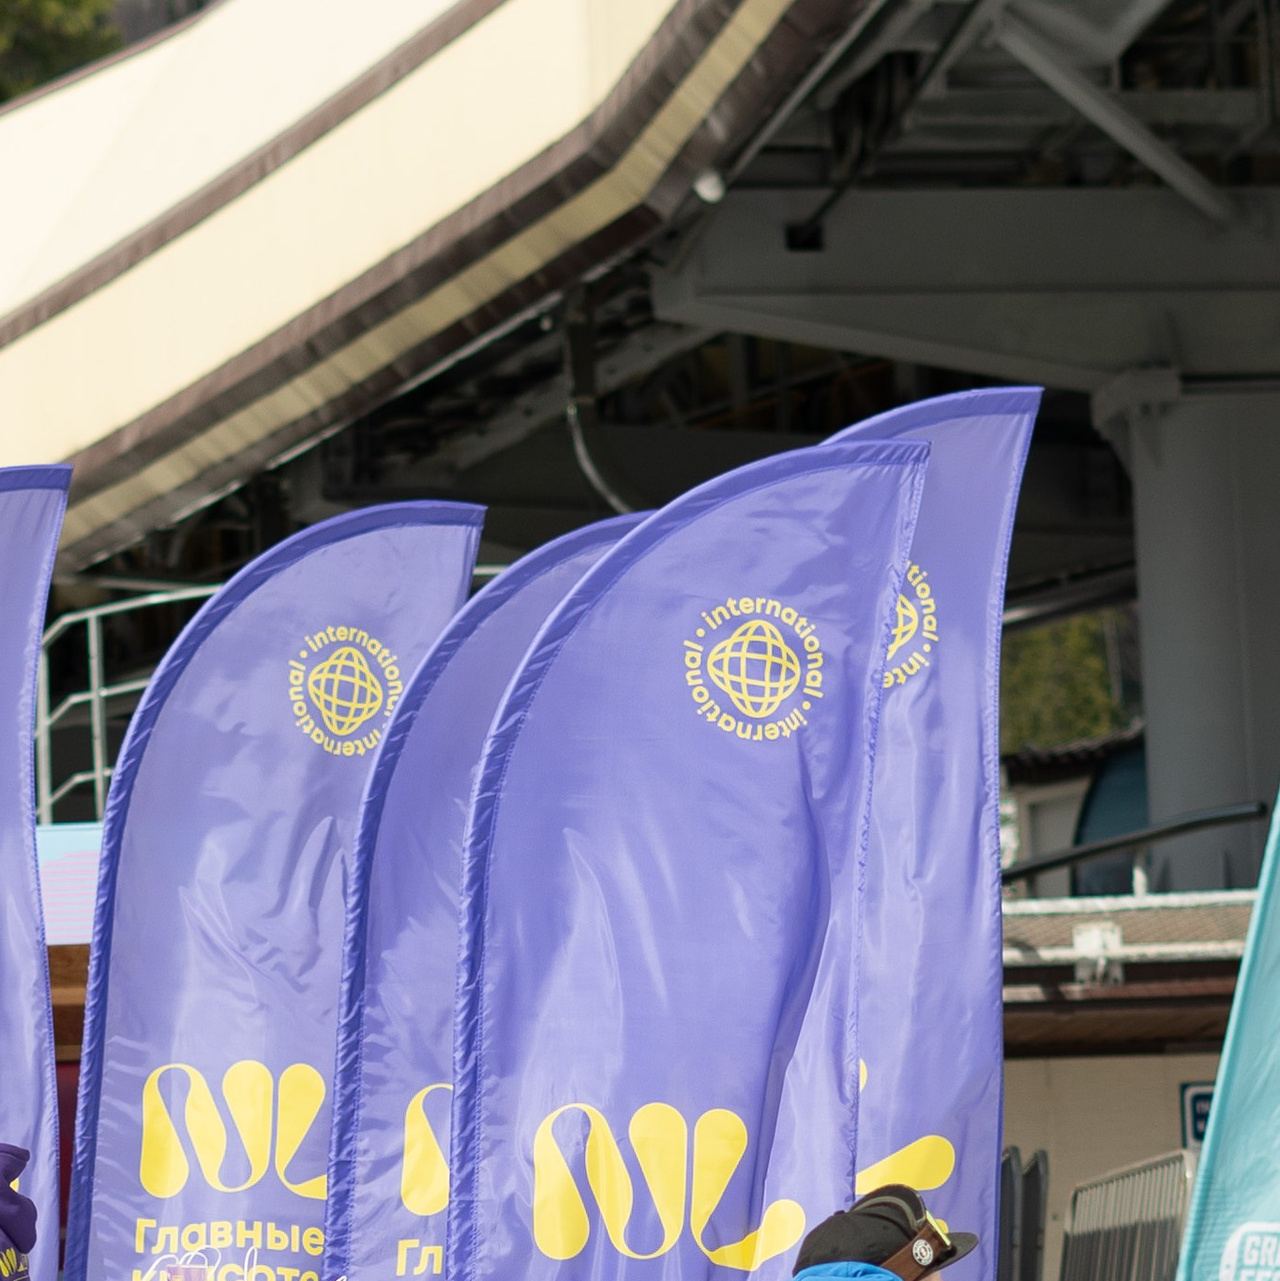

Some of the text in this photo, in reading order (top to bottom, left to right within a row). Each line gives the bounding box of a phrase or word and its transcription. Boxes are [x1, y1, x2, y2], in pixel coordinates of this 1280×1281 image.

[683, 639, 808, 741] international
[699, 597, 824, 698] international
[134, 1218, 325, 1256] Главные
